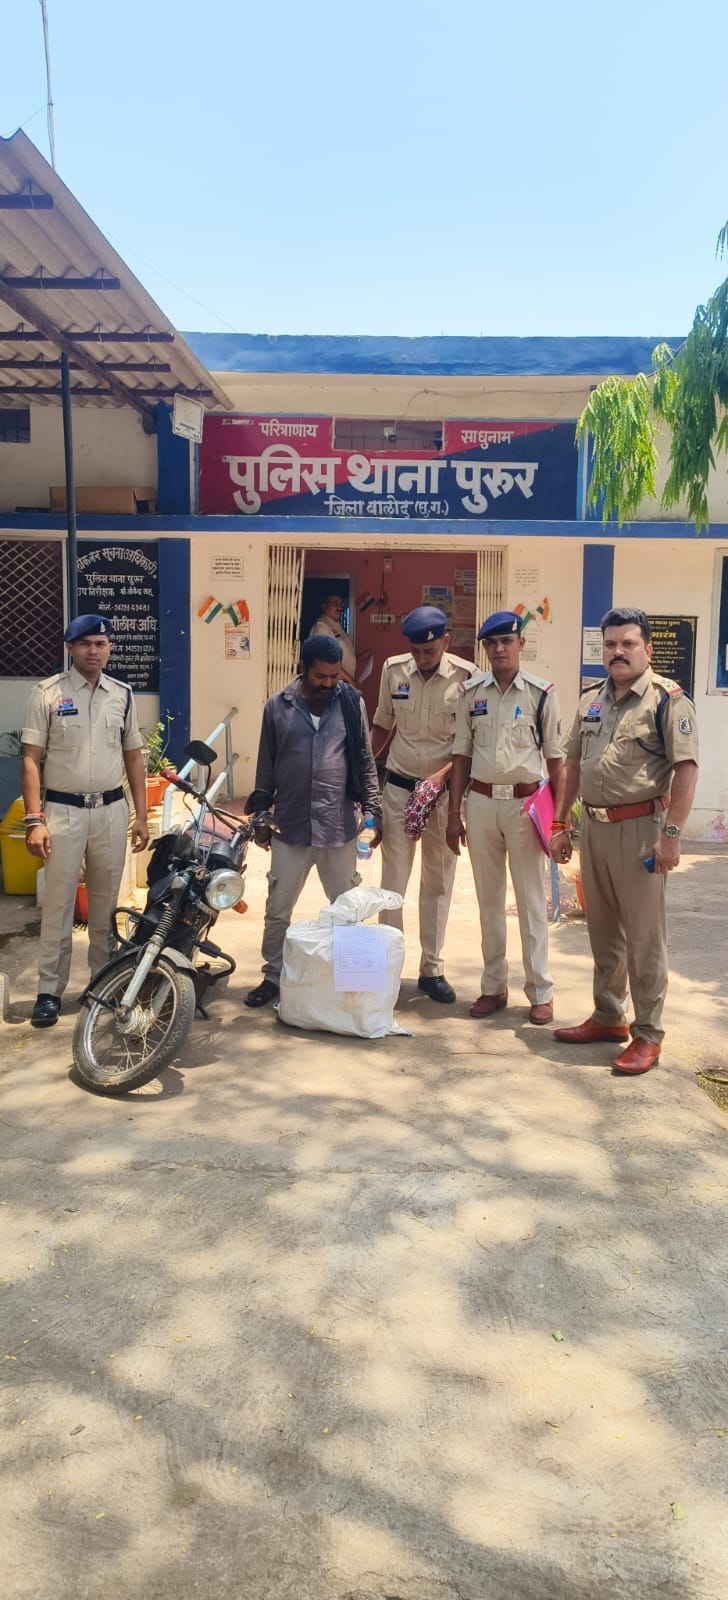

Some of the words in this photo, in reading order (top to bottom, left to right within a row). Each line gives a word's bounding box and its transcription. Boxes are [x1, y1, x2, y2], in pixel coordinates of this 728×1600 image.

[259, 419, 318, 438] परित्राणाय
[222, 444, 342, 514] पुलिस
[346, 455, 448, 495] थाना
[324, 494, 365, 516] जिला
[366, 494, 414, 518] बालोद
[85, 572, 108, 585] पुलिस
[110, 615, 138, 631] पीलीय
